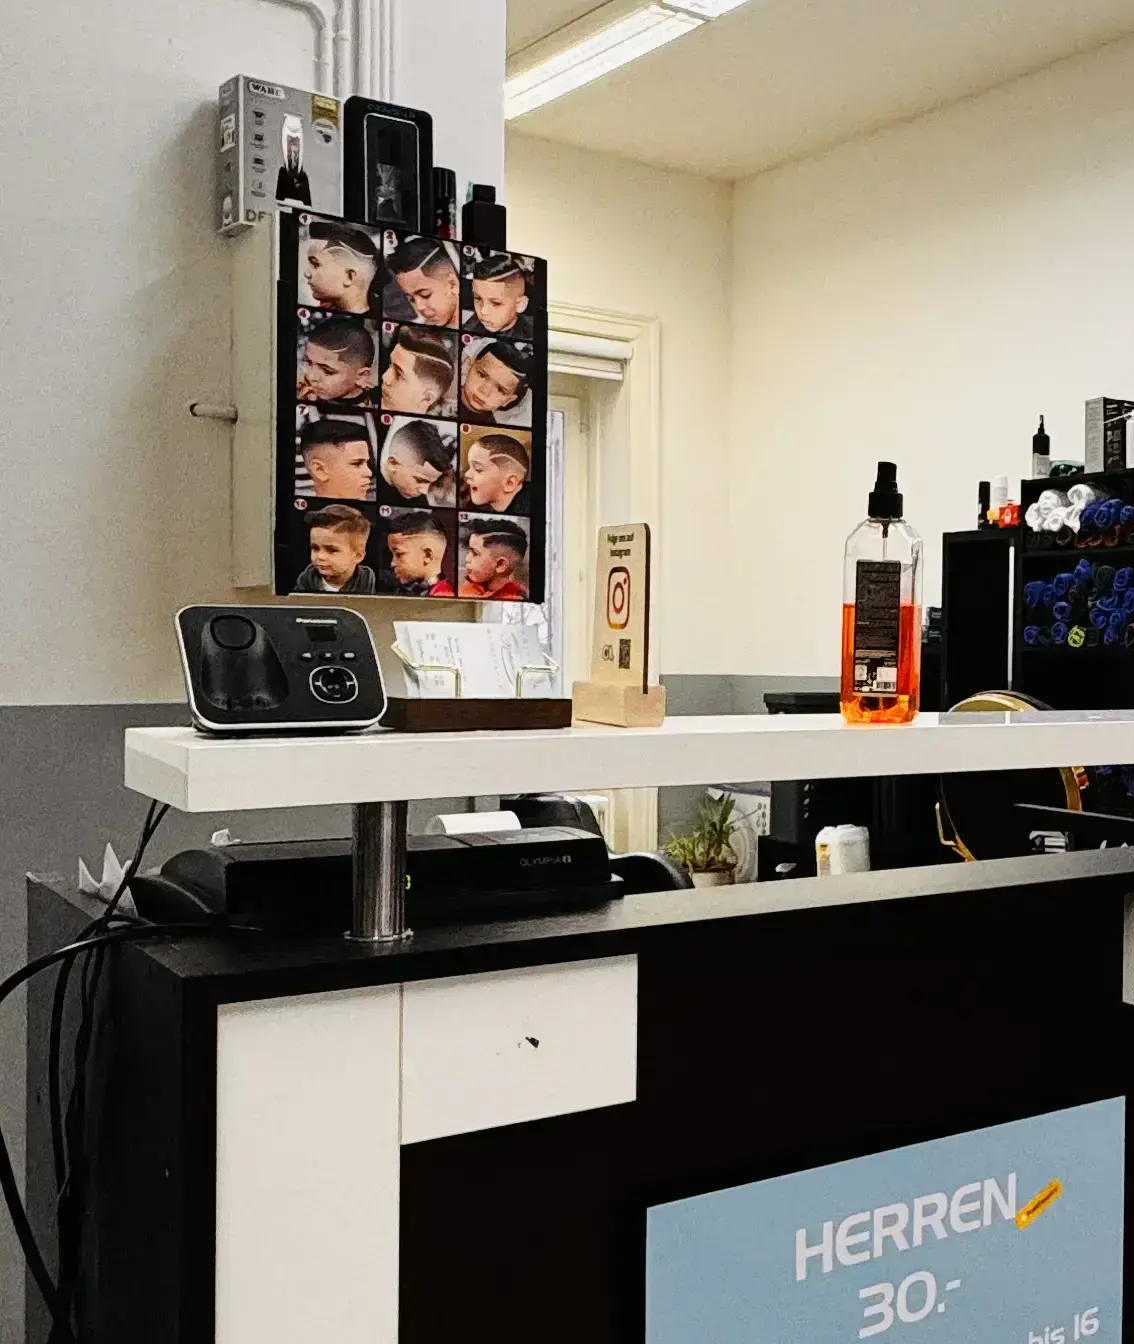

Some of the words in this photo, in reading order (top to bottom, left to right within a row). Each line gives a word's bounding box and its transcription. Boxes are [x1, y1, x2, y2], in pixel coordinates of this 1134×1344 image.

[793, 1171, 1018, 1283] HERREN
[858, 1279, 962, 1340] 30.-
[1072, 1305, 1101, 1344] 16
